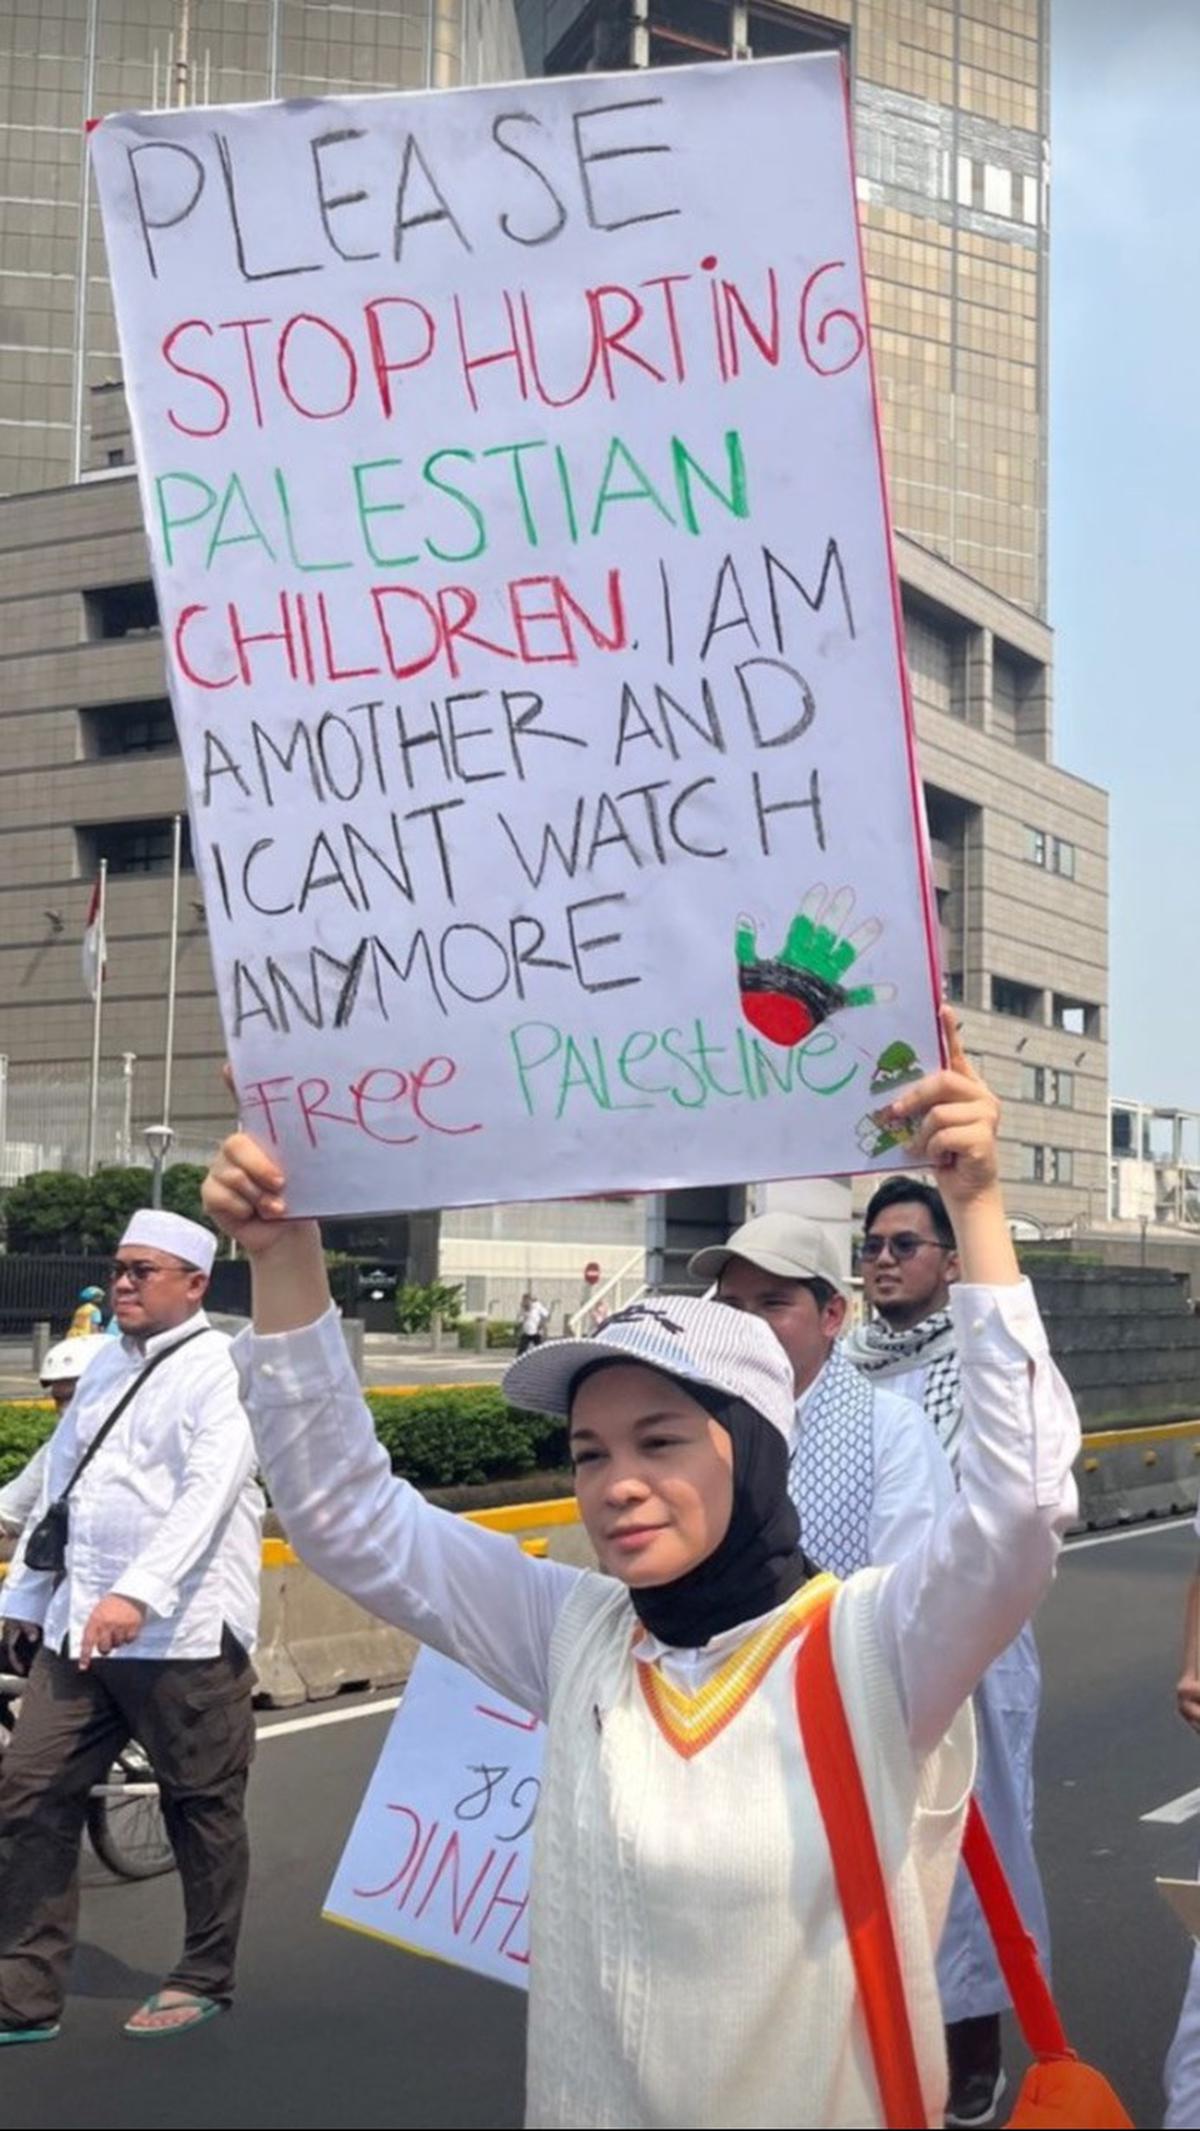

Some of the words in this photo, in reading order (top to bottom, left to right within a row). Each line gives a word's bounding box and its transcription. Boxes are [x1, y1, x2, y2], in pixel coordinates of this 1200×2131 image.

[126, 97, 681, 282] PLEASE
[161, 296, 436, 437] STOP
[152, 430, 750, 571] PALESTIAN
[659, 559, 675, 667] I
[699, 537, 856, 662] AM
[615, 658, 816, 767] AND
[211, 843, 233, 920] I
[241, 797, 466, 915] CANT
[498, 768, 827, 889] WATCH
[231, 891, 642, 1039] ANYMORE
